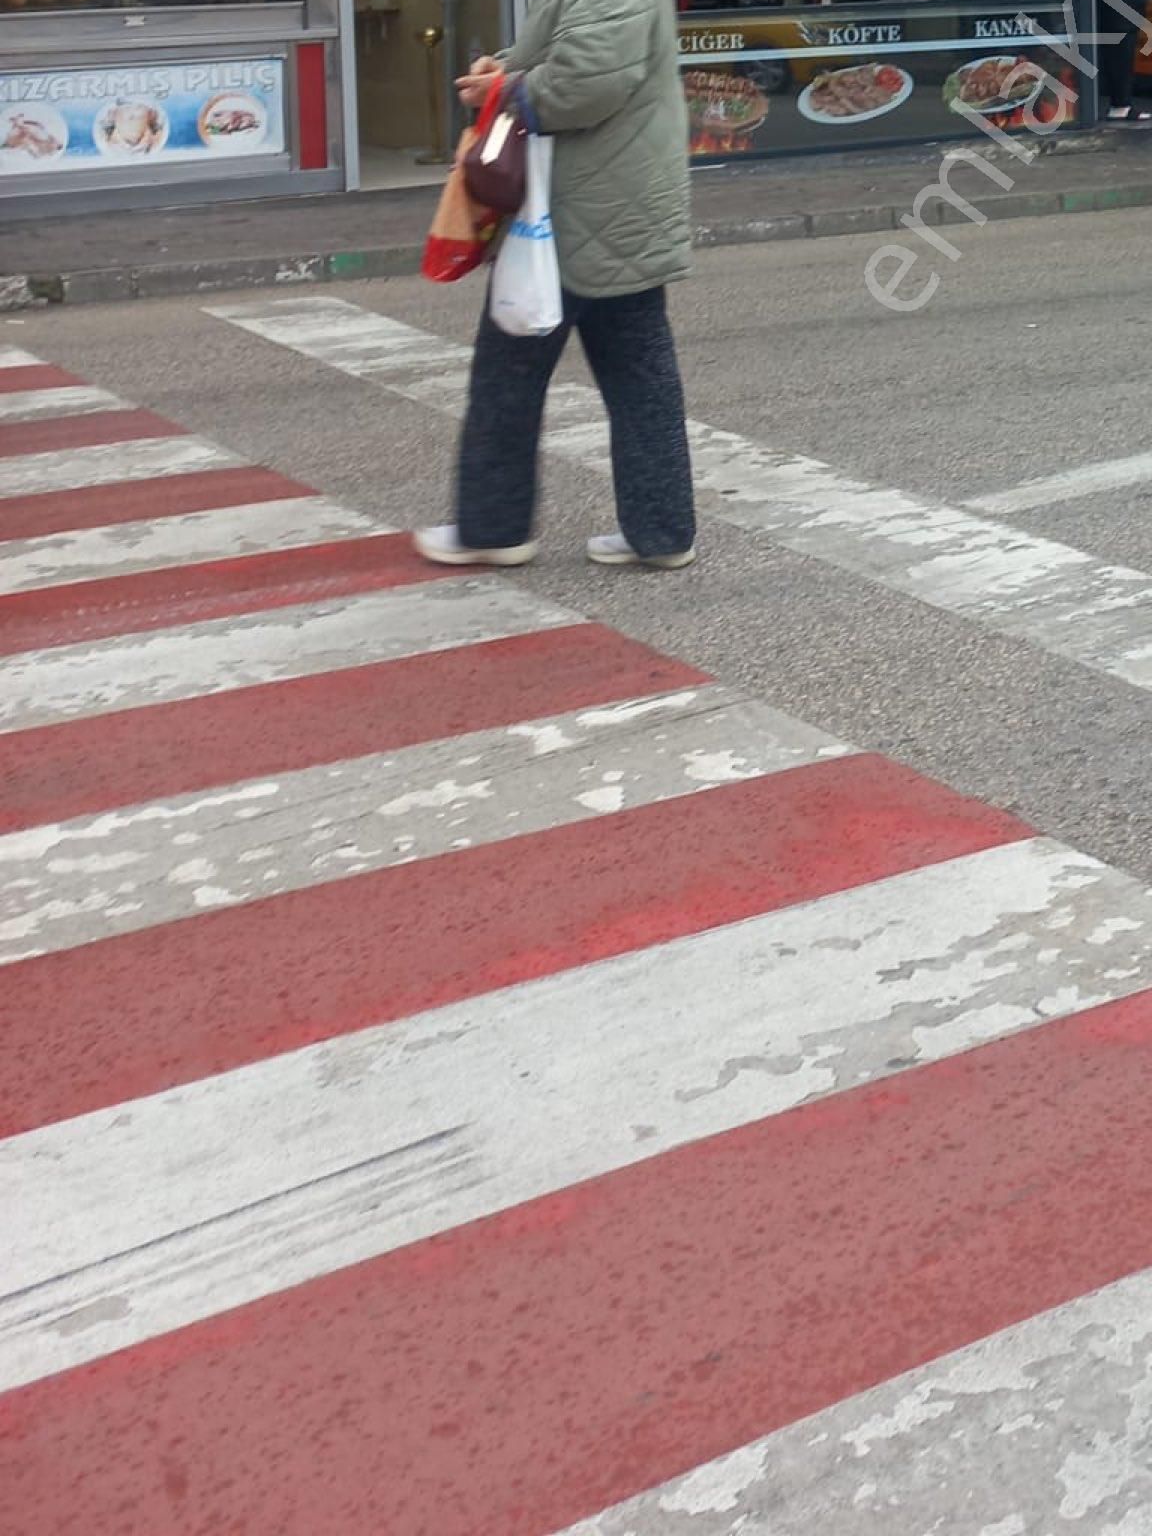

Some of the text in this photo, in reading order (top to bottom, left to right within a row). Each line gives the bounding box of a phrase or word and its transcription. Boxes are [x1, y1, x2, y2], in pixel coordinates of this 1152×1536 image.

[828, 23, 901, 45] KÖFTE
[975, 17, 1037, 37] KANAT
[676, 30, 745, 53] CİĞER
